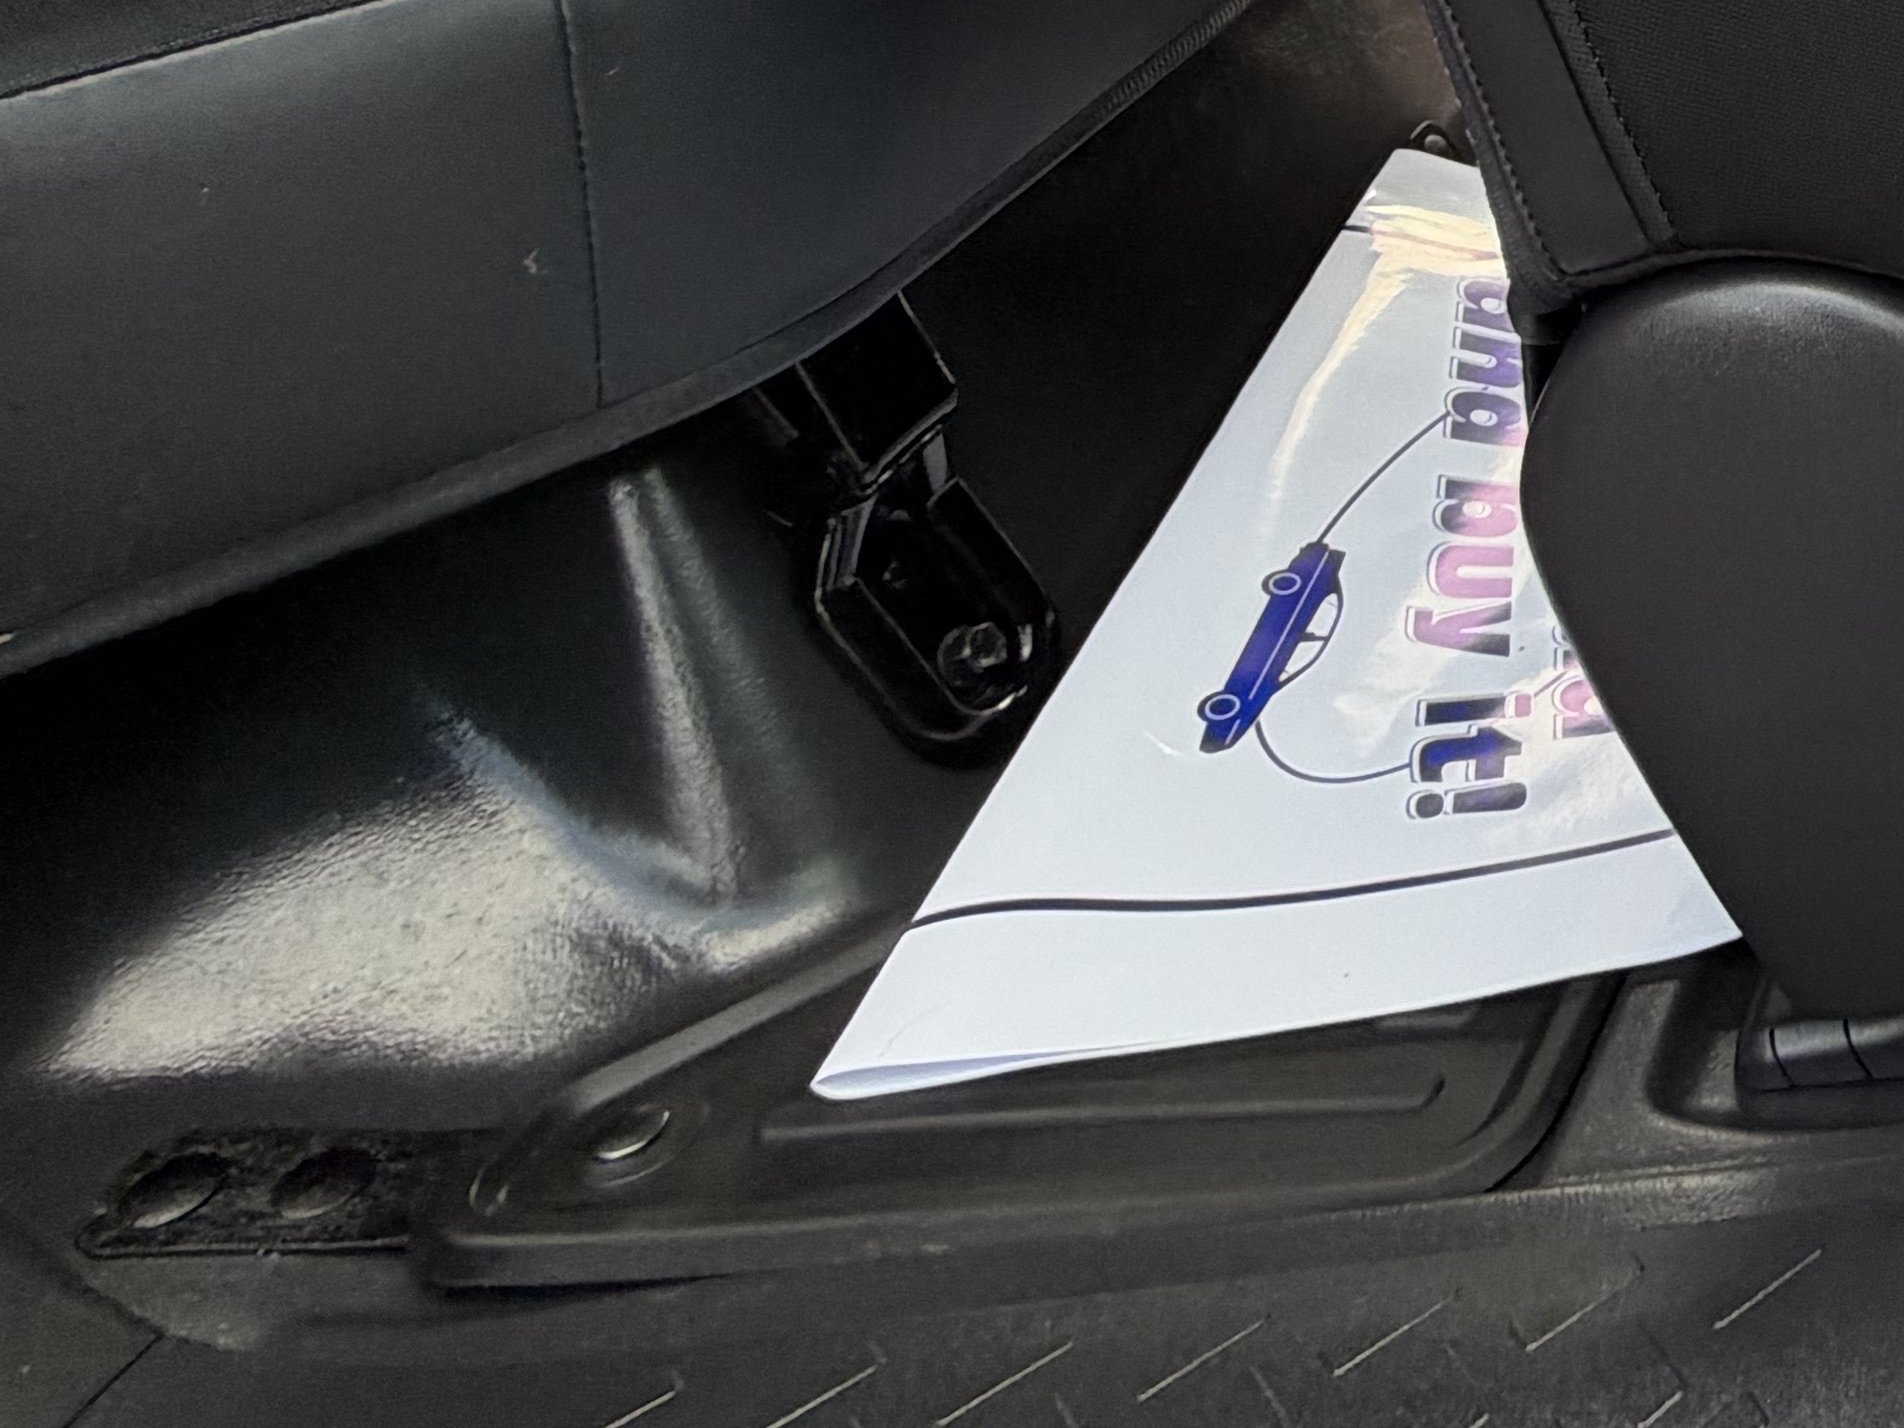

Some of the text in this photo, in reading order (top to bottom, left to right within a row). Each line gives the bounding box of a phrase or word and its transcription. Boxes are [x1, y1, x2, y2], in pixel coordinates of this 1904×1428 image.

[1405, 275, 1528, 820] and buy it!
